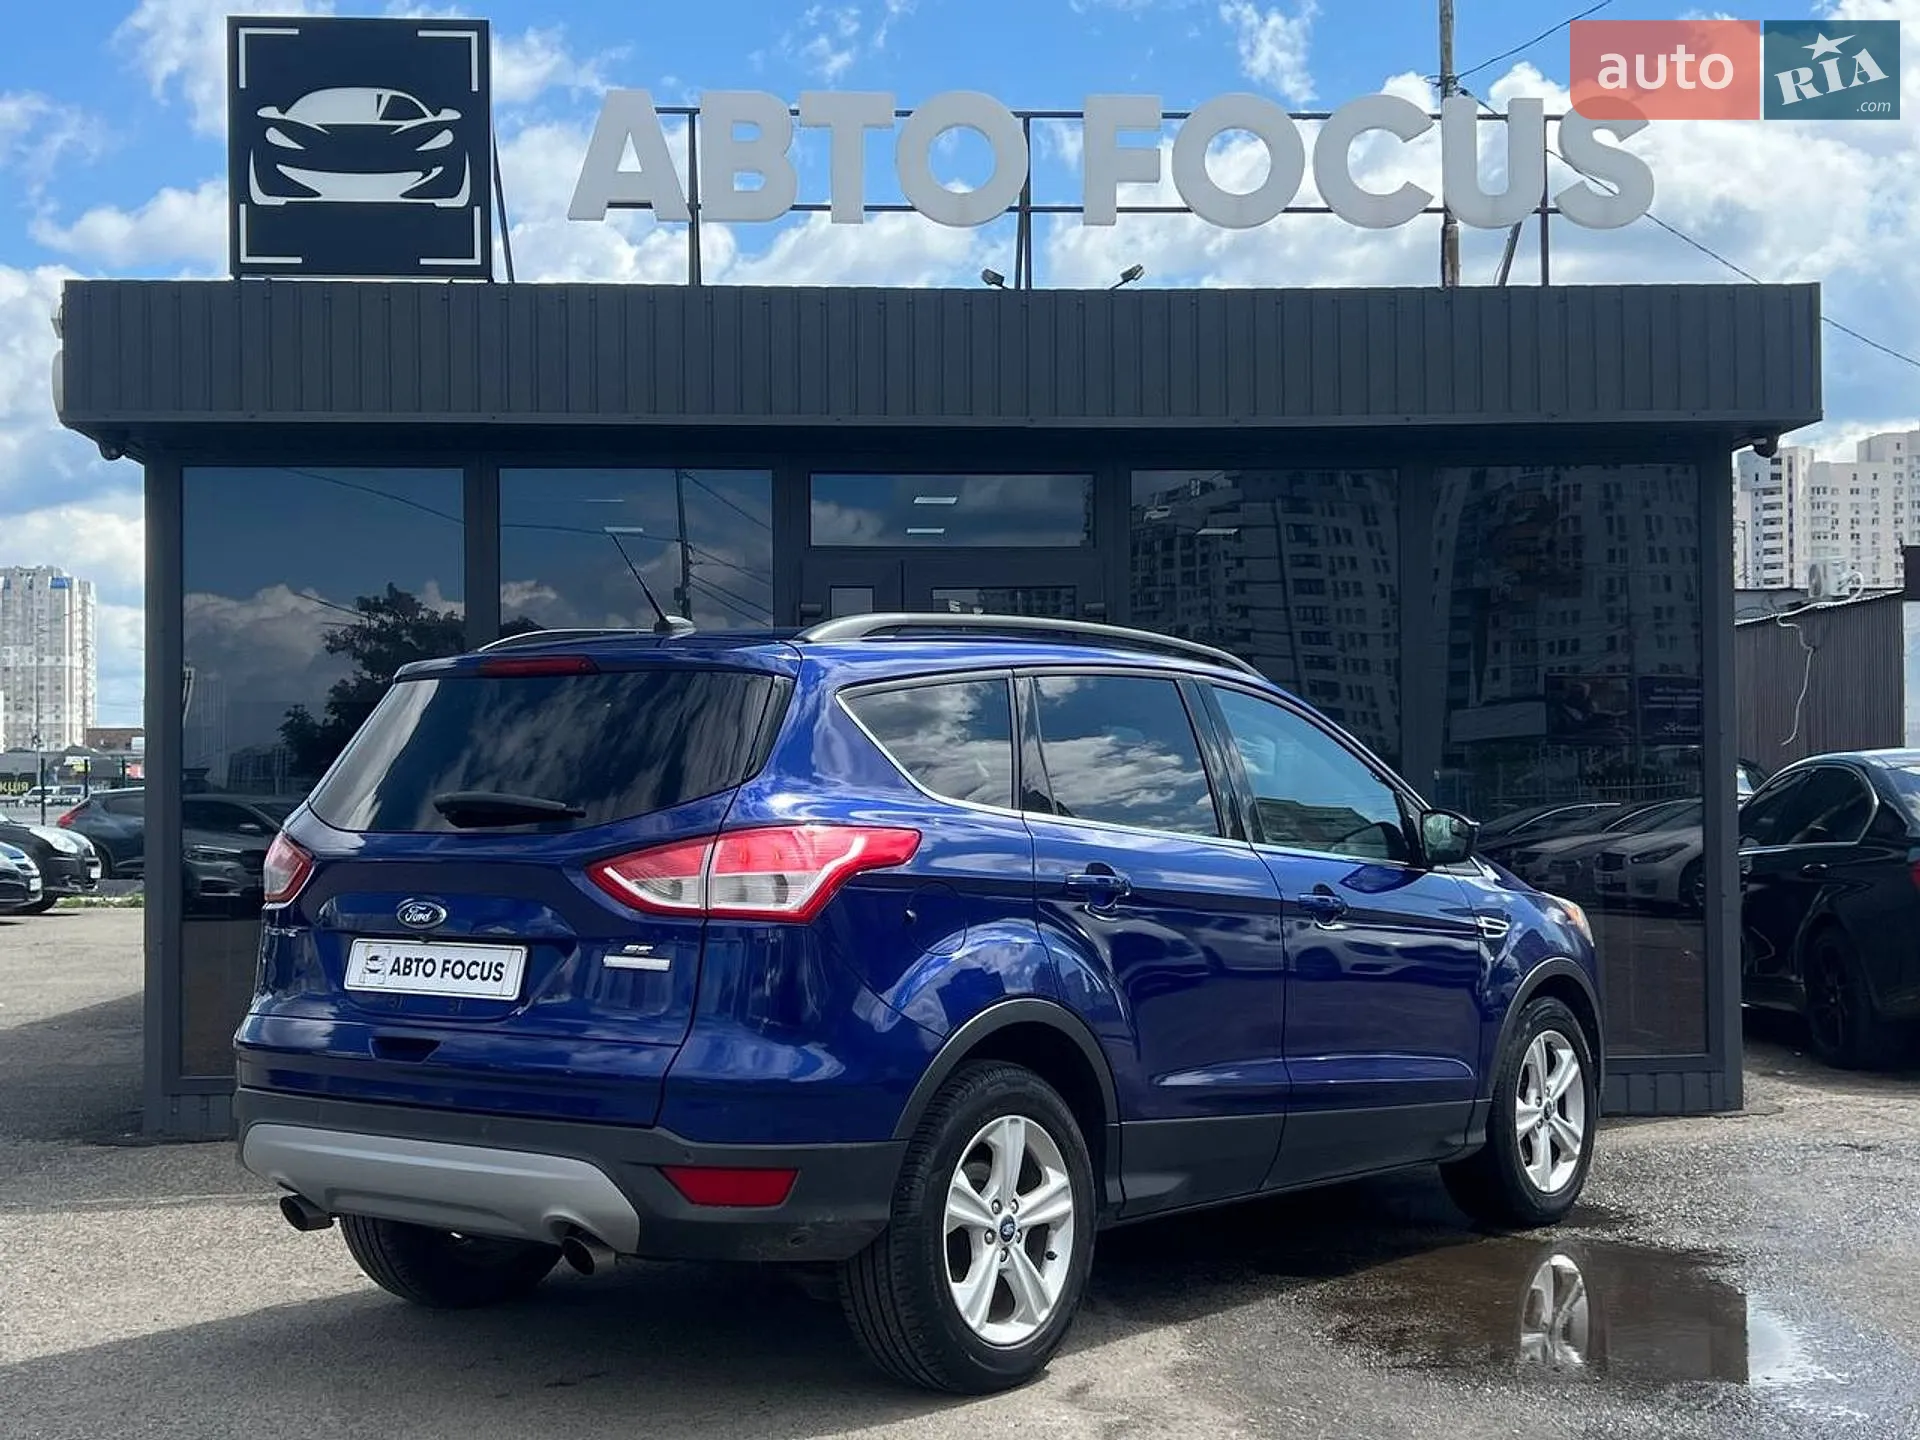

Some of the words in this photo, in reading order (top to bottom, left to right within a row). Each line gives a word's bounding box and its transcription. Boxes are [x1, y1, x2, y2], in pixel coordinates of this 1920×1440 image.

[567, 90, 1029, 227] АВТО
[1083, 93, 1655, 231] FOCUS
[403, 904, 436, 923] Ford
[389, 956, 436, 978] АВТО
[440, 959, 505, 983] FOCUS
